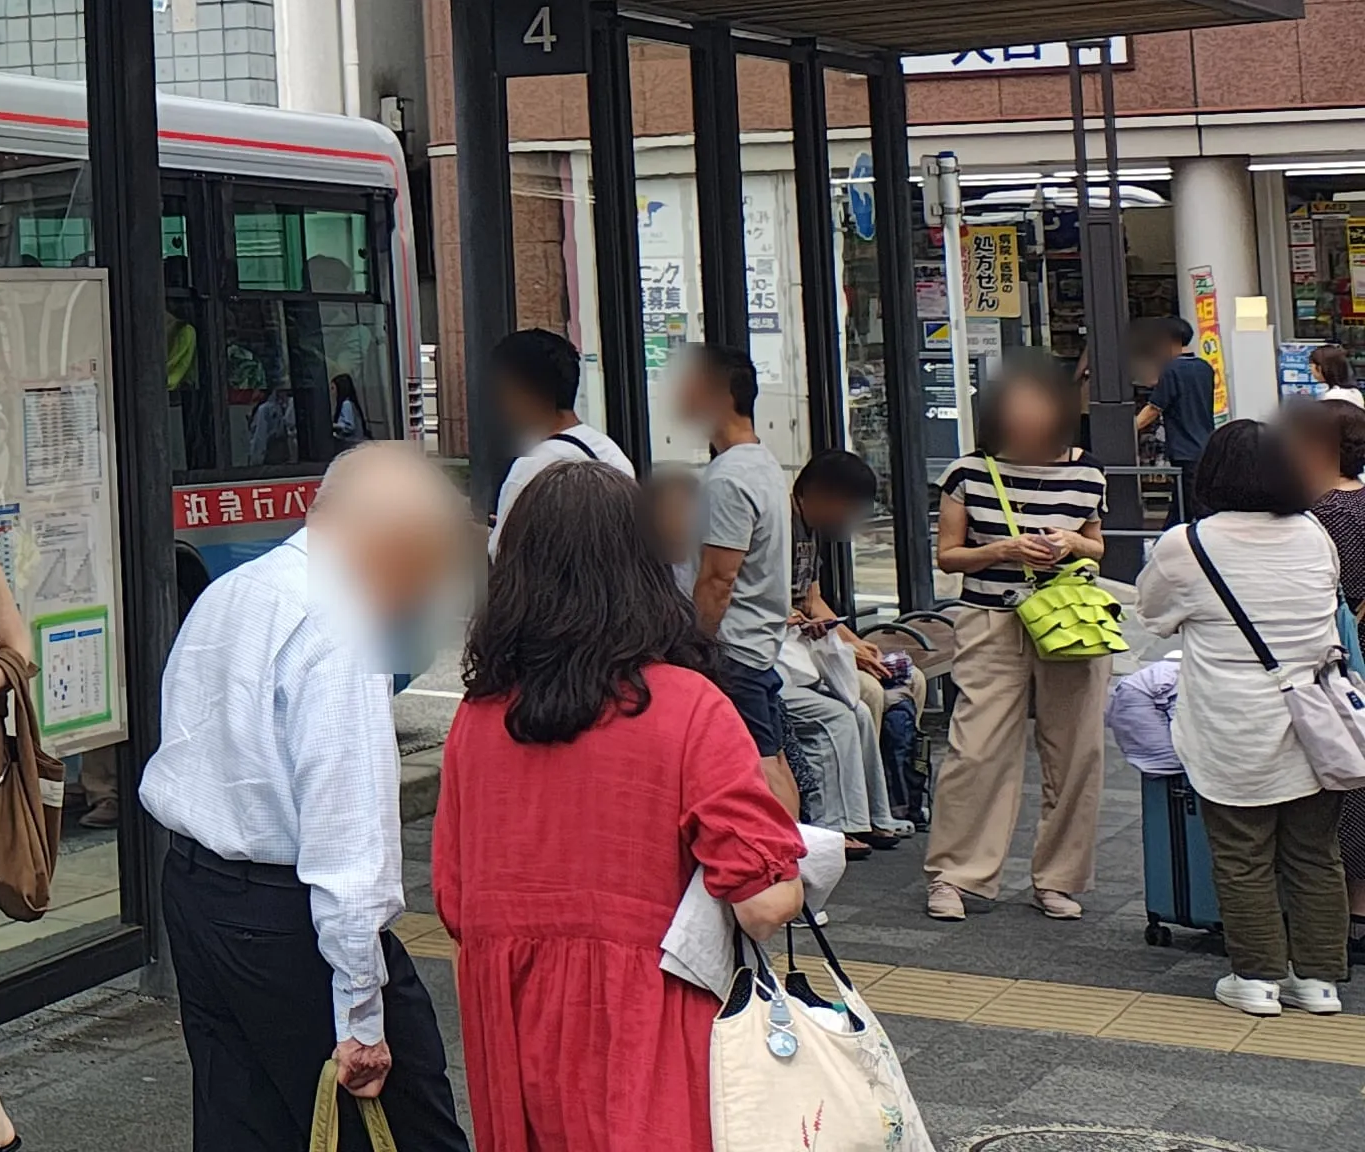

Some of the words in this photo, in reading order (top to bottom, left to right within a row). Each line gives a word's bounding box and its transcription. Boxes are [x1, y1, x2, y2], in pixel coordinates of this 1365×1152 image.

[522, 5, 558, 53] 4
[973, 235, 998, 311] 処方せん
[183, 486, 321, 526] 浜急行バ
